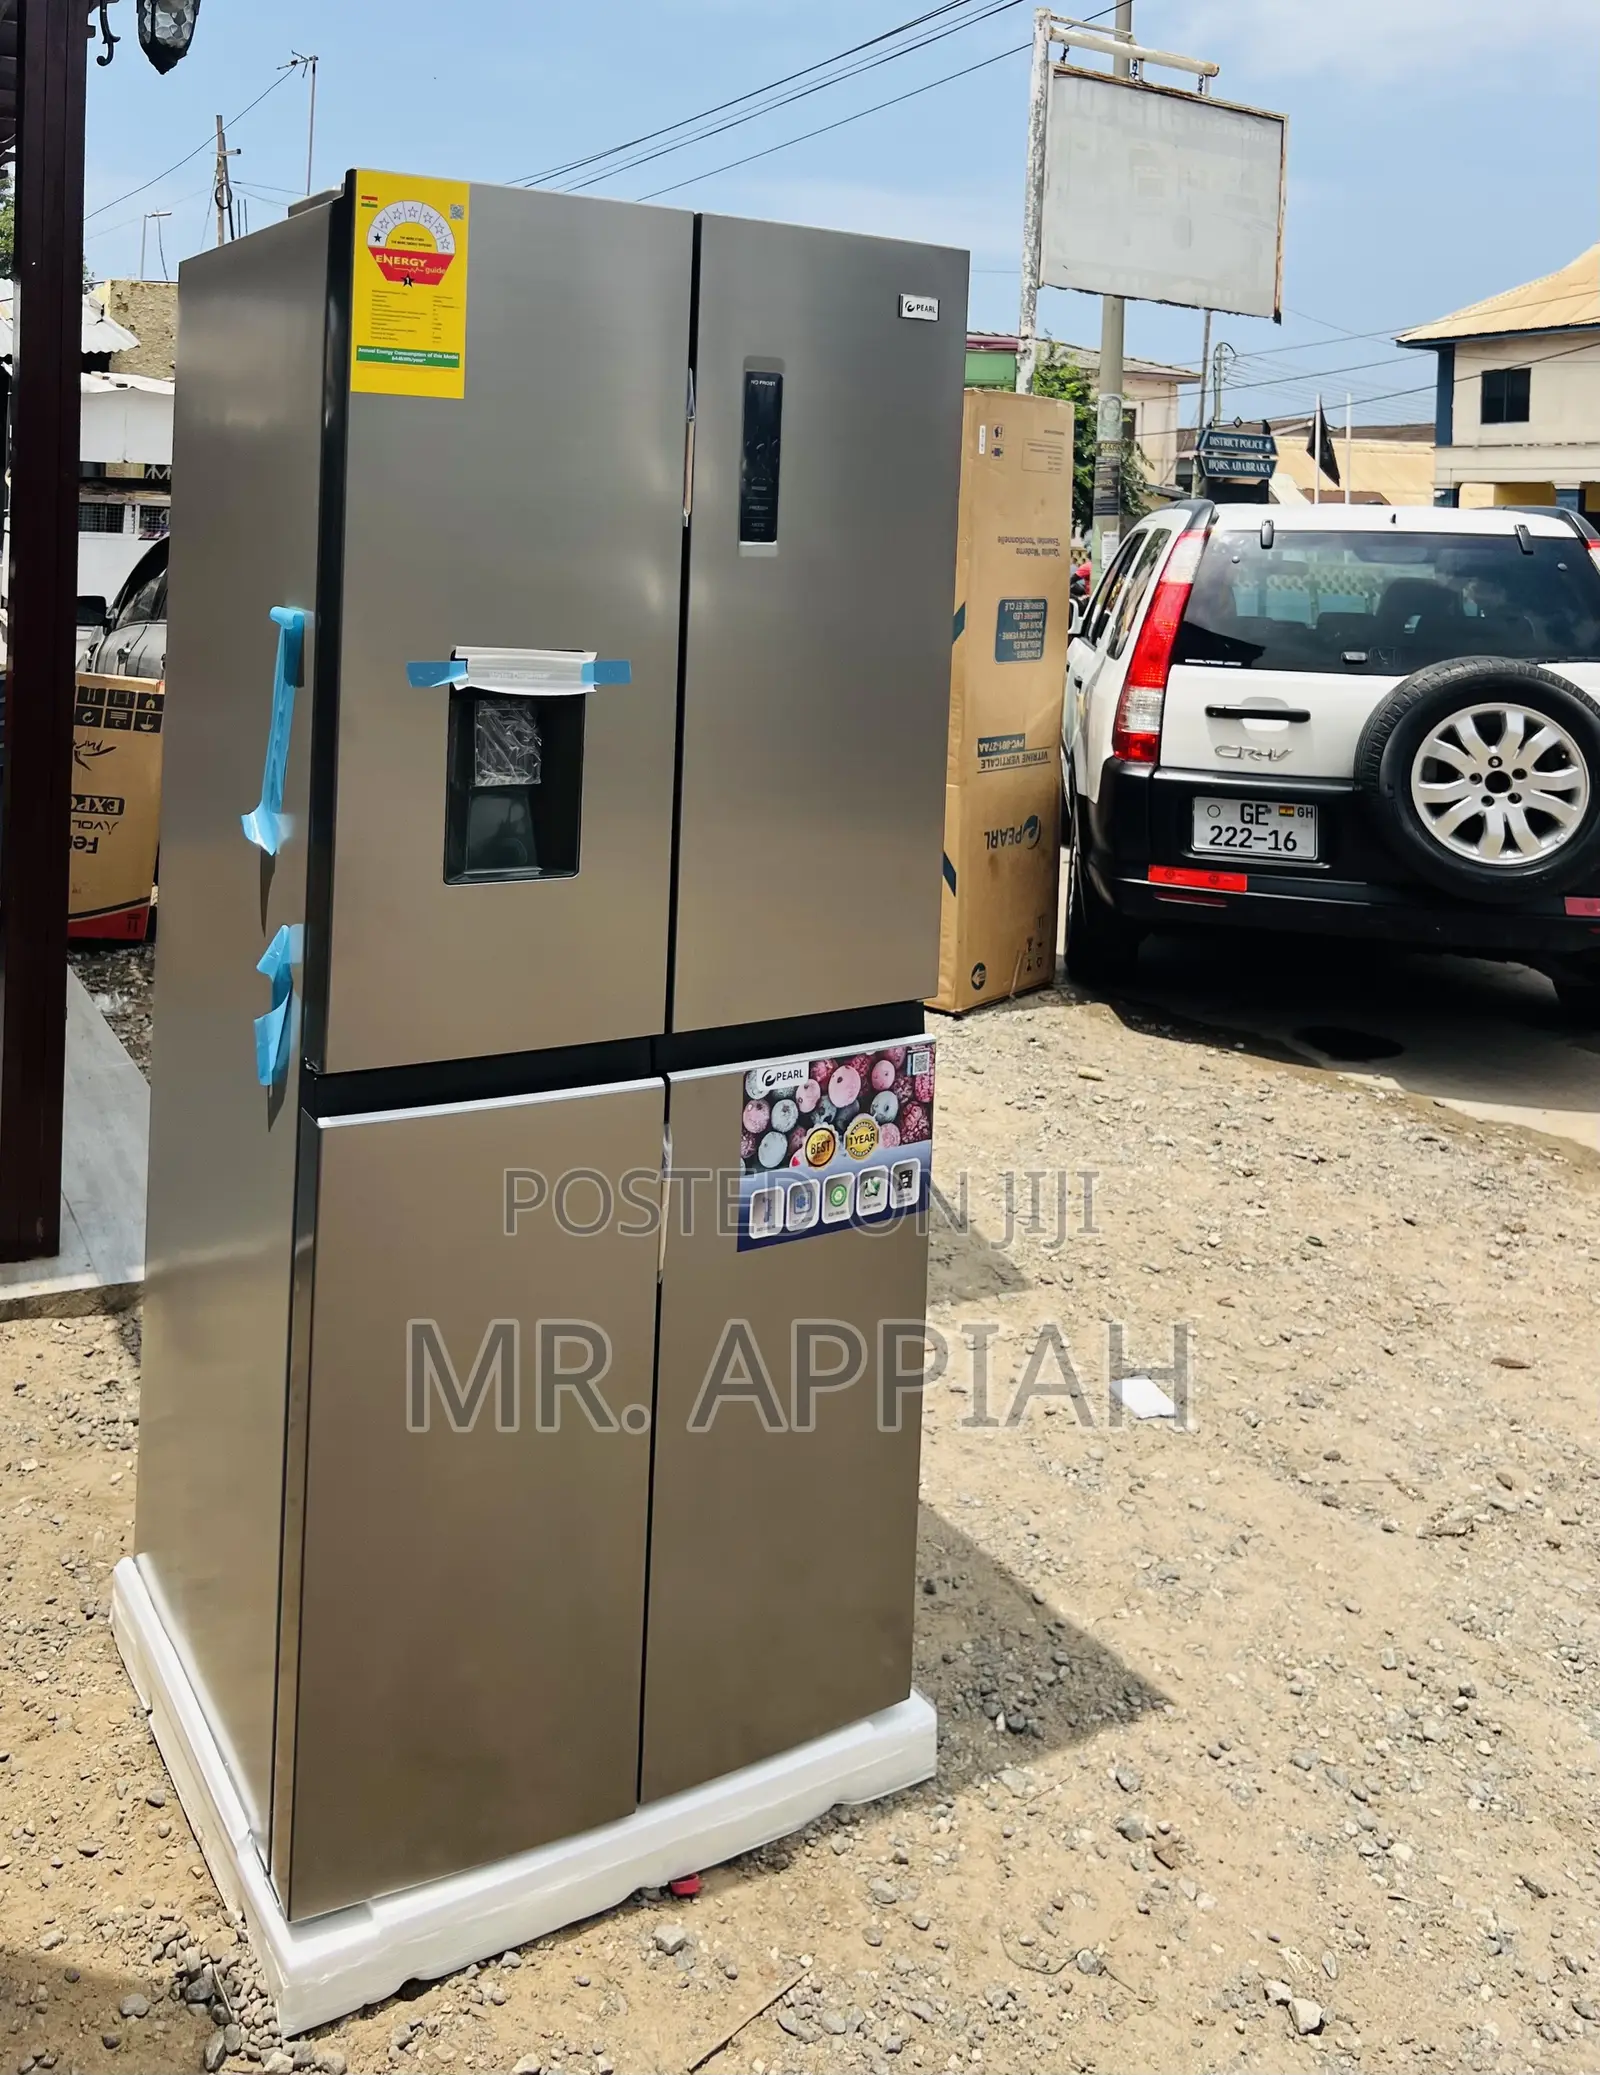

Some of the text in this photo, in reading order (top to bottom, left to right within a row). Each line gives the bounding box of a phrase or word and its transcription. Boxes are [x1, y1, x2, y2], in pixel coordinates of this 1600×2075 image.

[375, 253, 428, 268] ENERGY
[425, 266, 446, 275] guide
[916, 303, 936, 314] PEARL
[376, 348, 394, 356] Energy
[393, 350, 427, 358] Consumption
[1209, 436, 1264, 450] DISTRICT POLICE
[1231, 461, 1271, 473] ADABRAKA
[980, 750, 1048, 769] VITRINE VERTICALE
[1240, 803, 1269, 826] GE
[1297, 807, 1313, 819] GH
[983, 823, 1022, 850] PEARL
[1209, 825, 1298, 852] 222-16
[70, 835, 99, 855] Fe
[776, 1068, 804, 1082] PEARL
[854, 1132, 876, 1145] YEAR
[810, 1140, 831, 1155] BEST
